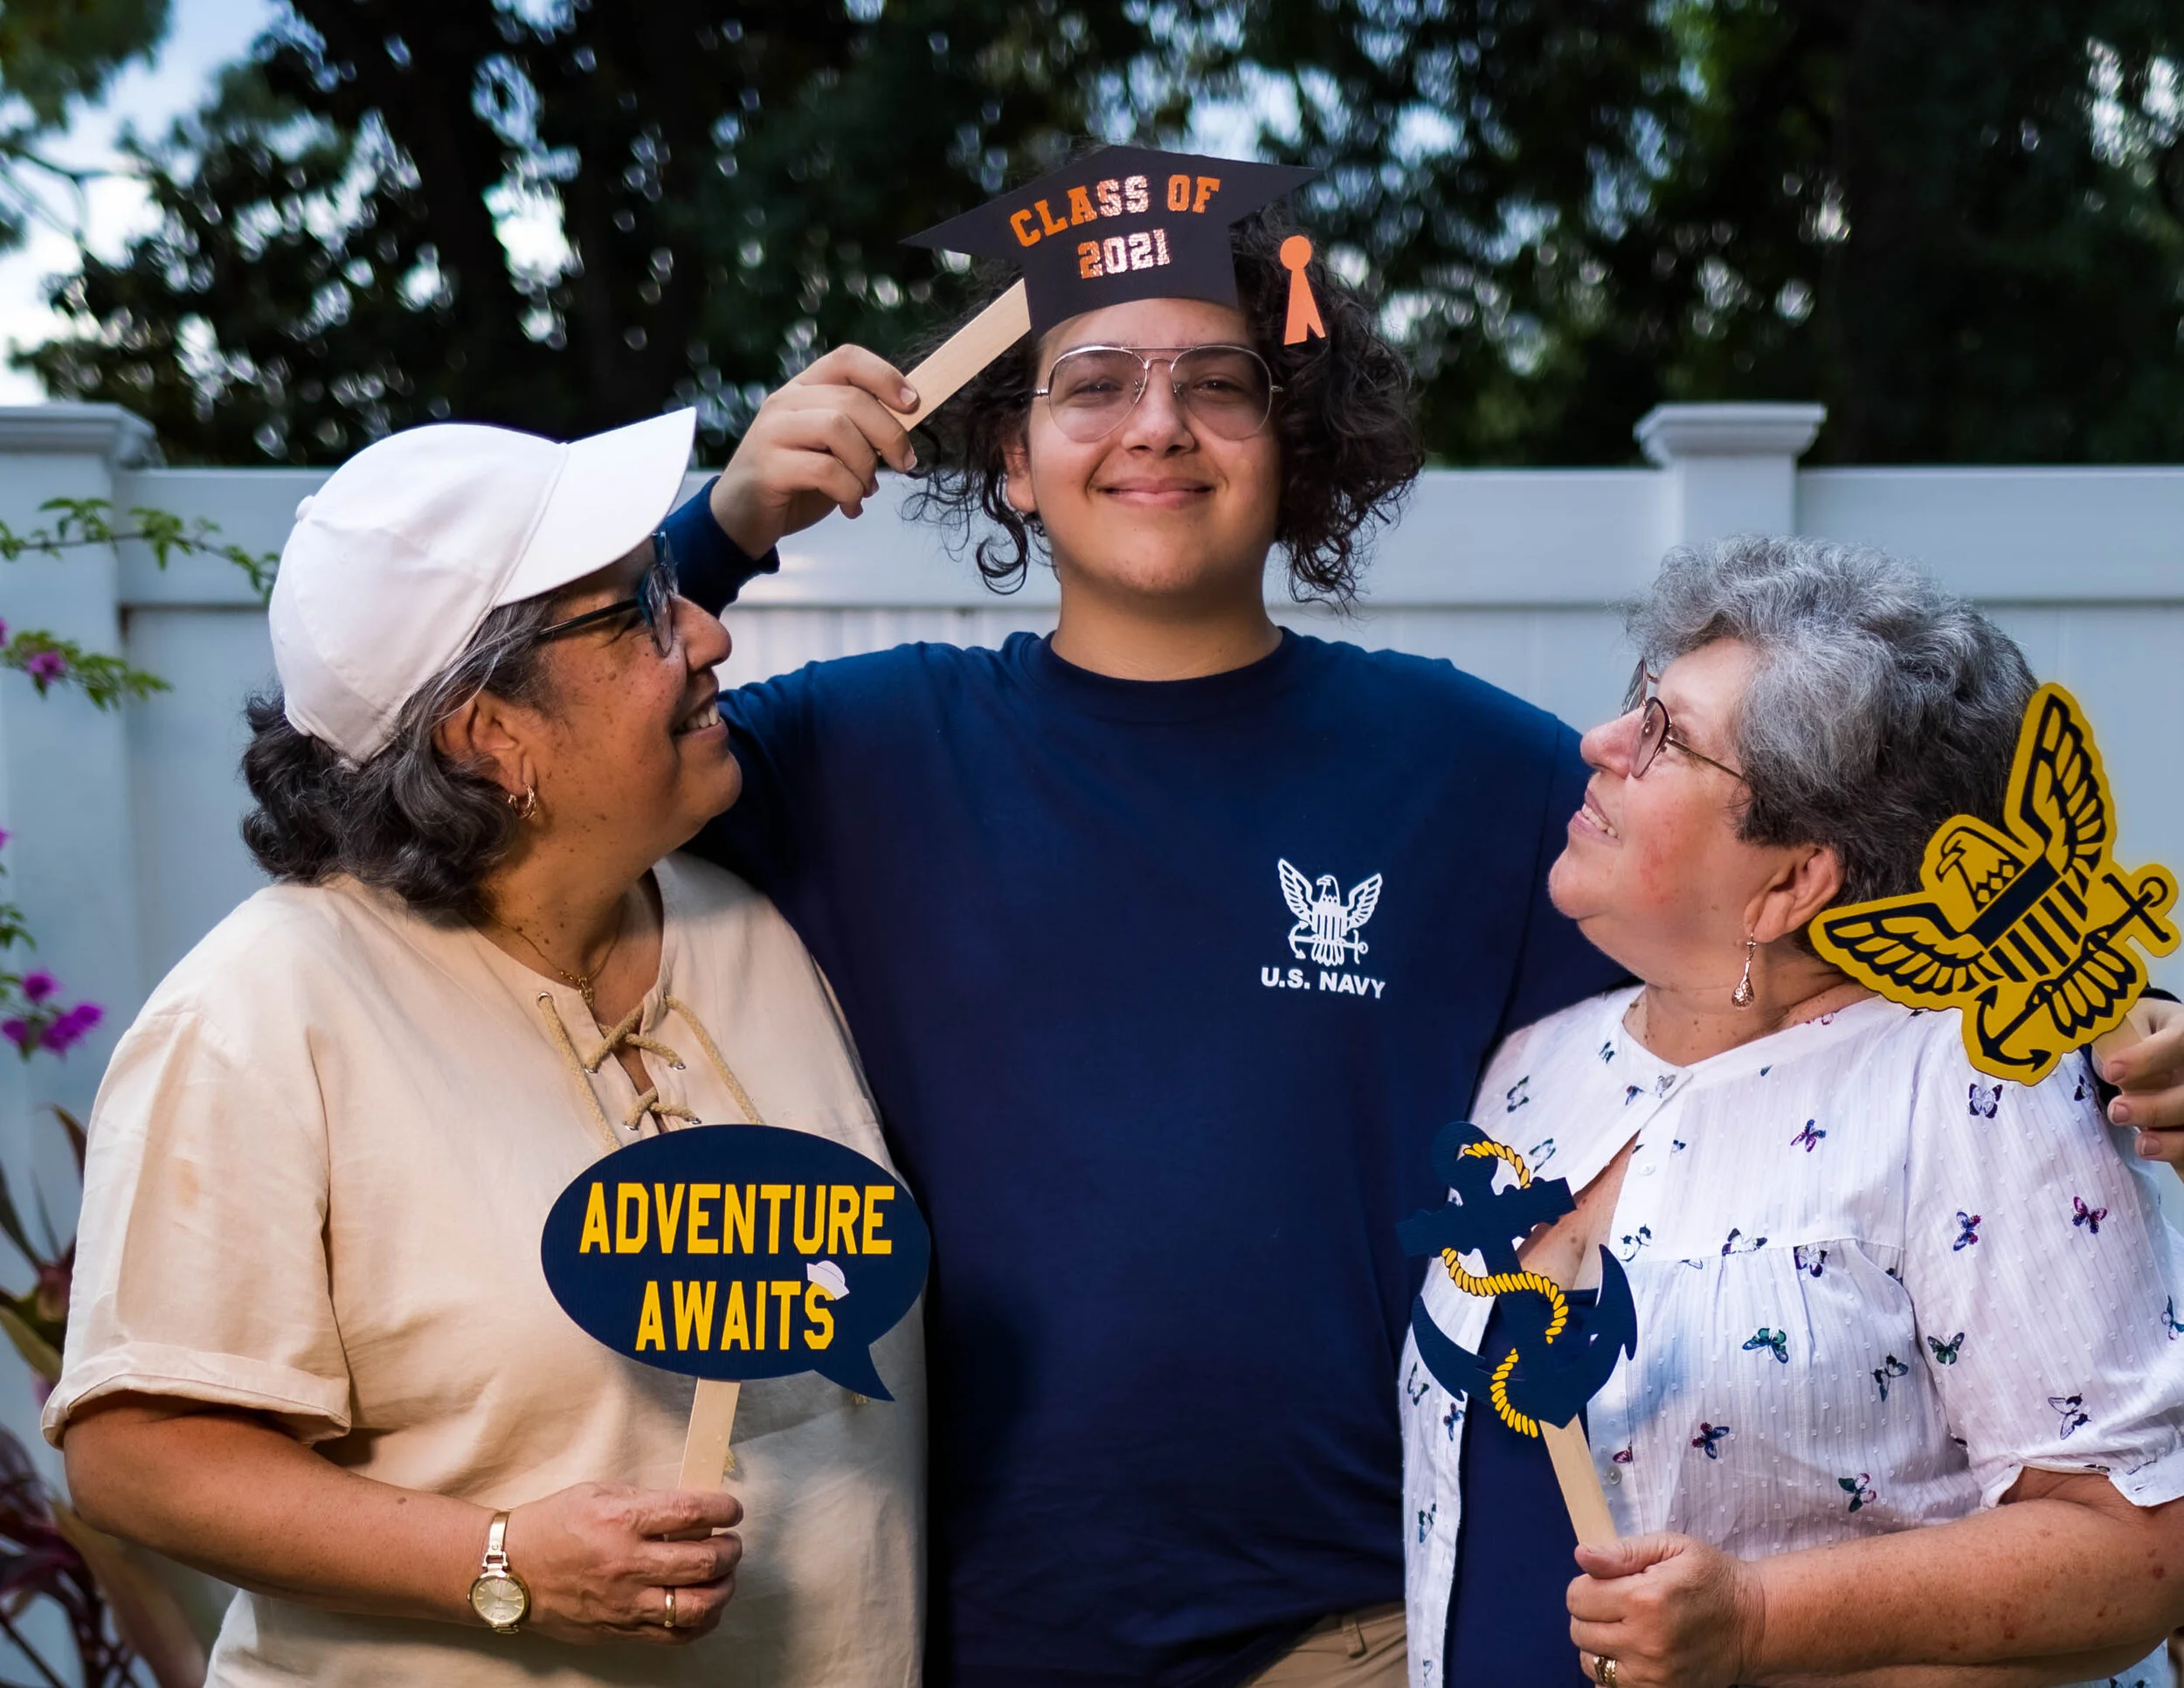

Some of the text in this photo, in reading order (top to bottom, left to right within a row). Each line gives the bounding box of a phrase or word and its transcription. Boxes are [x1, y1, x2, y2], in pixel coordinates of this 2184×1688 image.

[1009, 174, 1221, 248] CLASS OF
[1077, 228, 1171, 280] 2021
[1261, 967, 1386, 1000] U.S. NAVY
[579, 1181, 895, 1255] ADVENTURE
[635, 1280, 835, 1352] AWAITS
